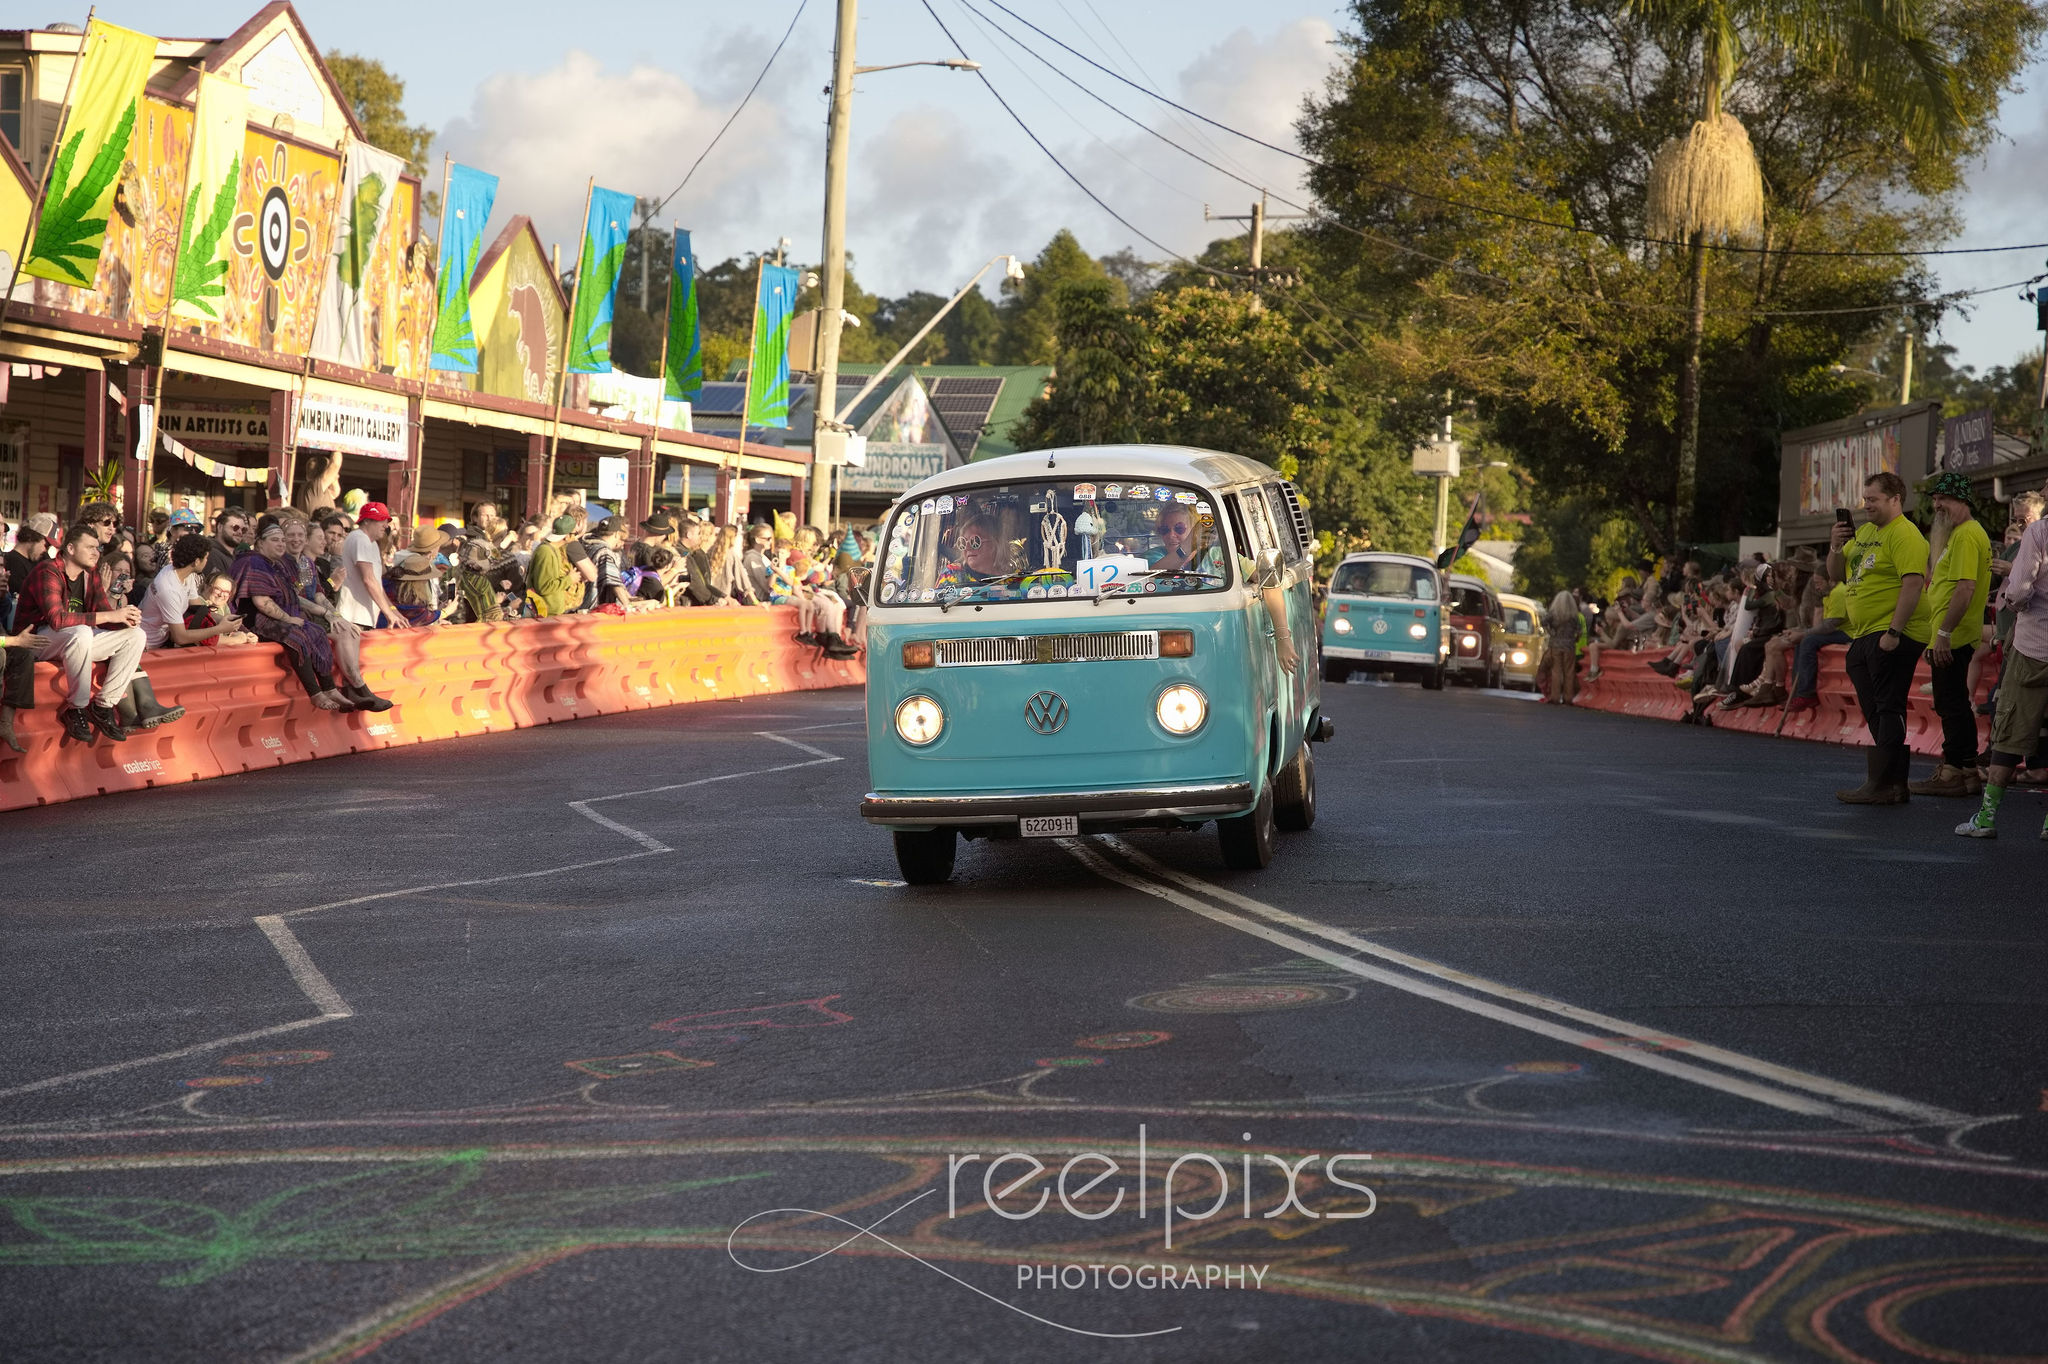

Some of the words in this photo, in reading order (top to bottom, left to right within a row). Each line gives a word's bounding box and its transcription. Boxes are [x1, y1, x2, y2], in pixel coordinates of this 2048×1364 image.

[186, 417, 242, 435] ARTISTS
[300, 408, 331, 430] NIMBIN
[334, 412, 364, 437] ARTISTS
[367, 418, 401, 443] GALLERY
[854, 455, 941, 477] UNDROMAT
[1083, 564, 1118, 590] 12
